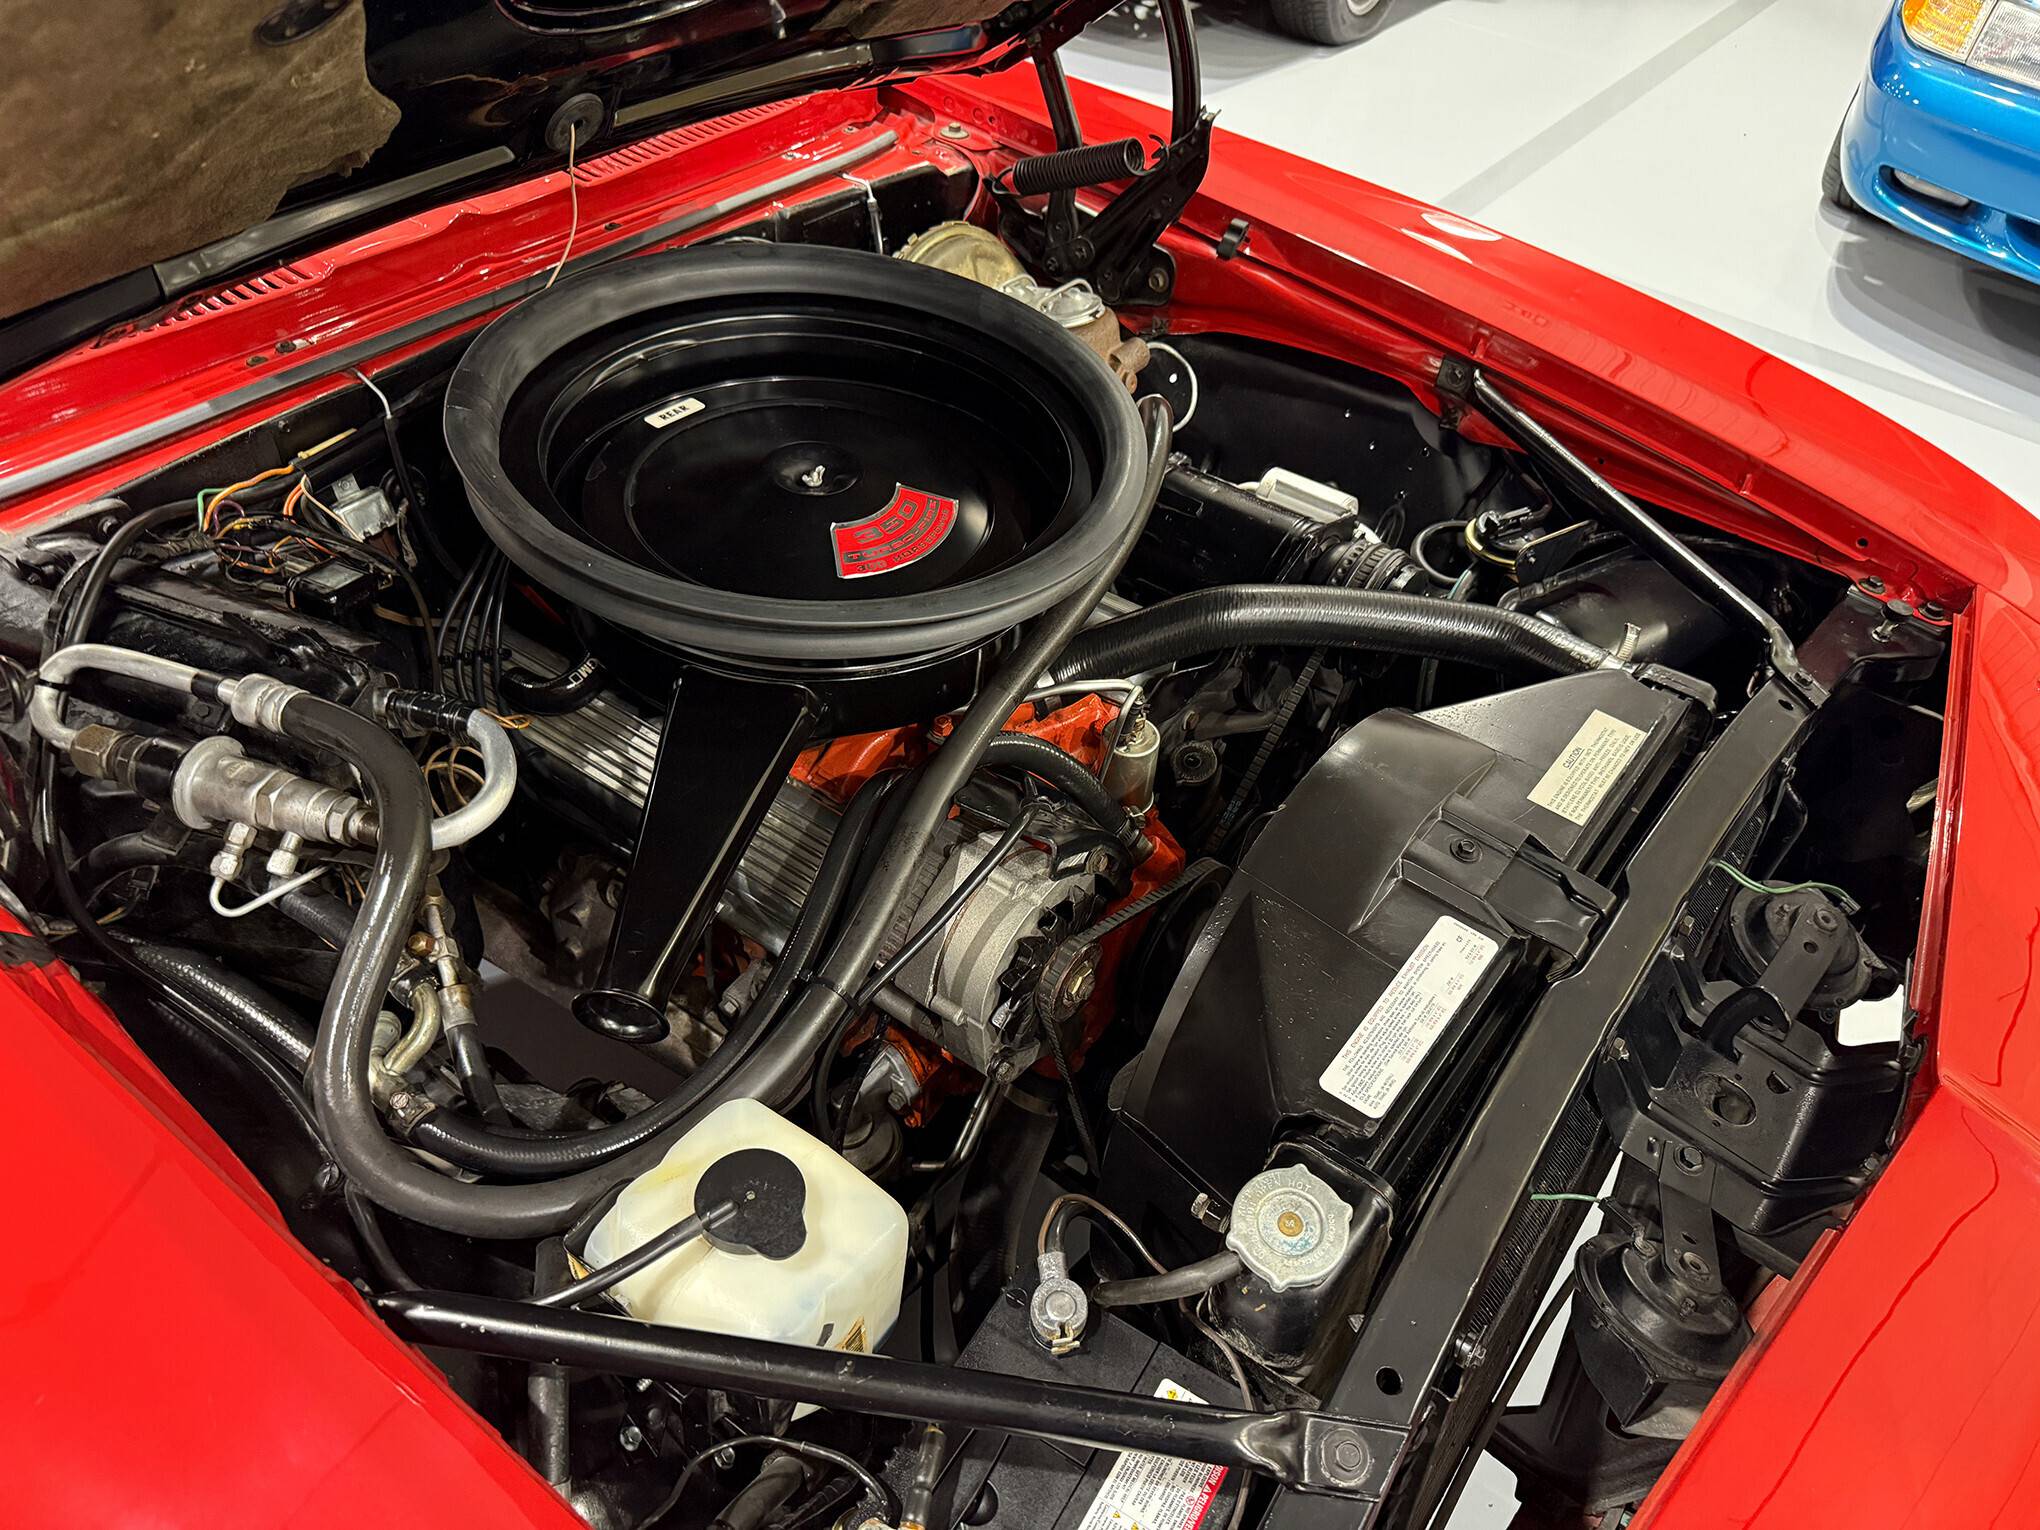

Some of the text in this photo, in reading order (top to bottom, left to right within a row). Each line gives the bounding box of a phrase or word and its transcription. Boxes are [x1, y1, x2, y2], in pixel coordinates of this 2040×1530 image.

[658, 404, 690, 421] REAR
[854, 499, 918, 544] 350
[1563, 746, 1582, 769] CAUTION
[1288, 1180, 1311, 1192] HOT
[1210, 1465, 1224, 1486] OISON
